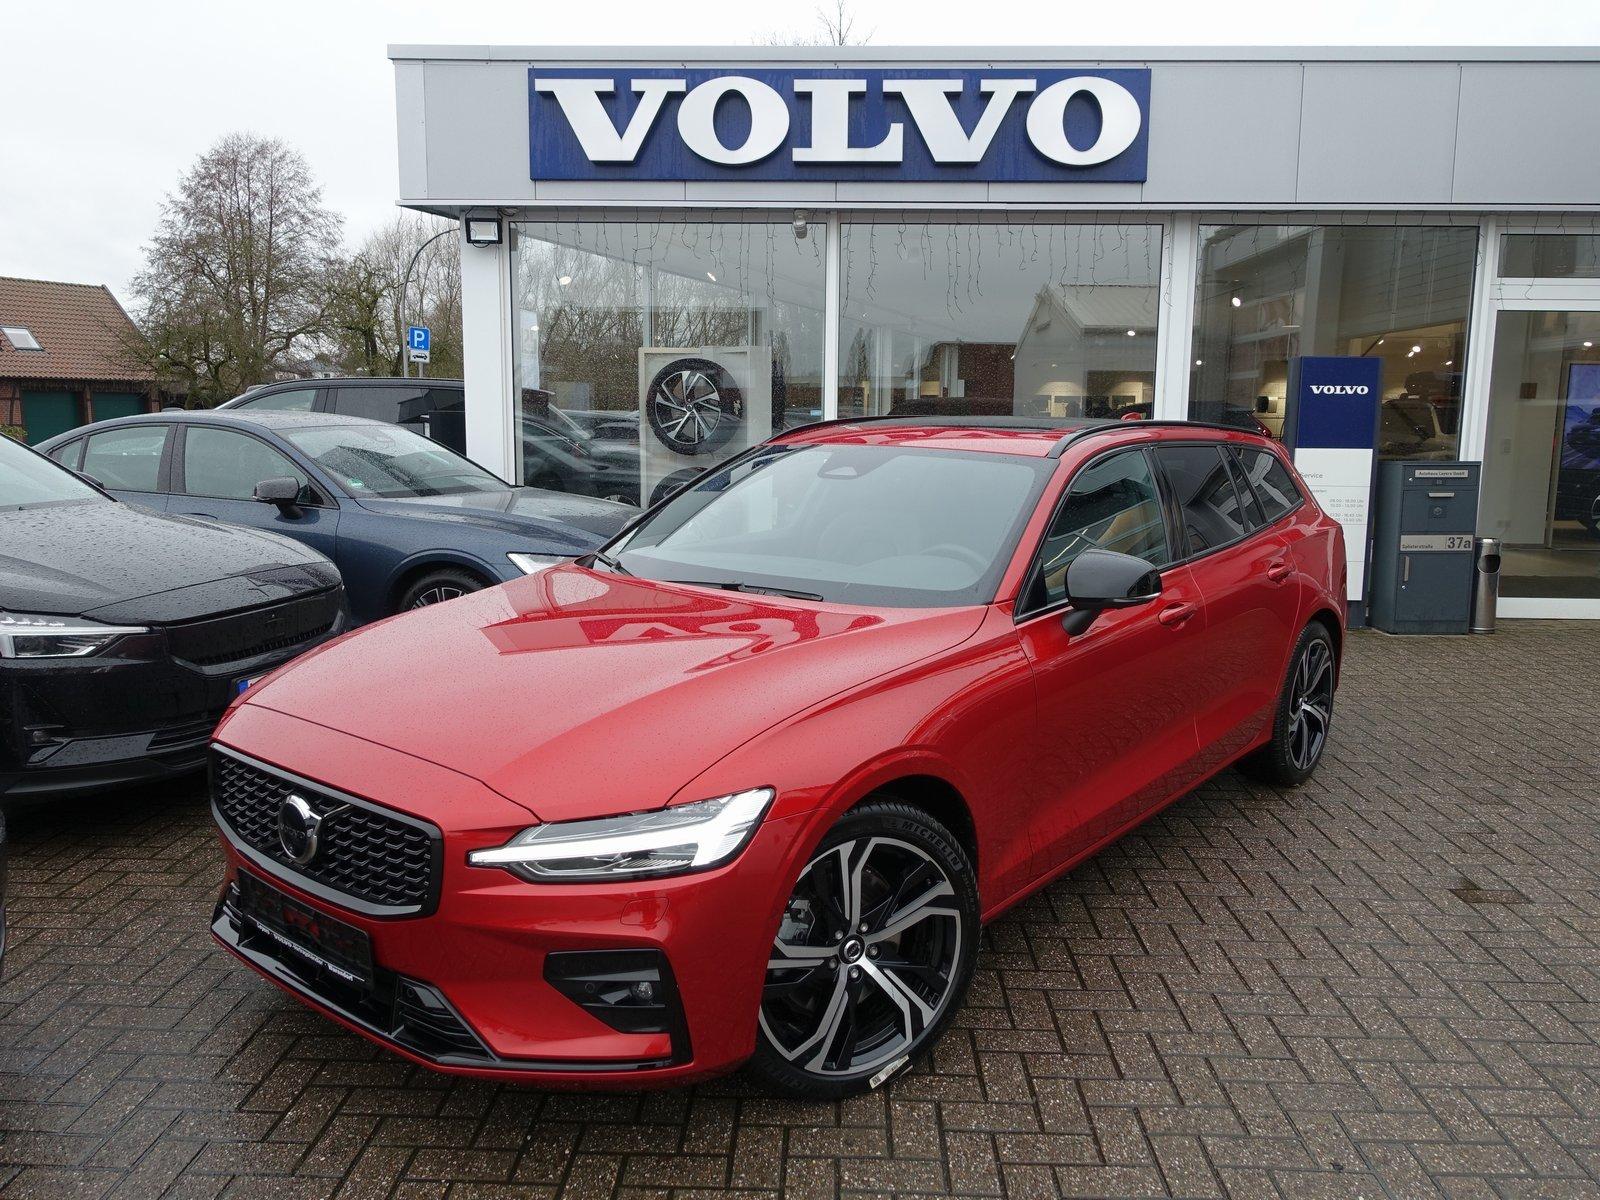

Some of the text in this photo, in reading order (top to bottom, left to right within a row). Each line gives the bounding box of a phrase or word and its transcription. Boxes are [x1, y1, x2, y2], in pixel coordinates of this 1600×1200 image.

[534, 76, 1142, 166] VOLVO
[414, 330, 425, 347] P
[1309, 385, 1369, 395] VOLVO
[1447, 536, 1471, 549] 37a
[902, 820, 961, 867] MICHELIN
